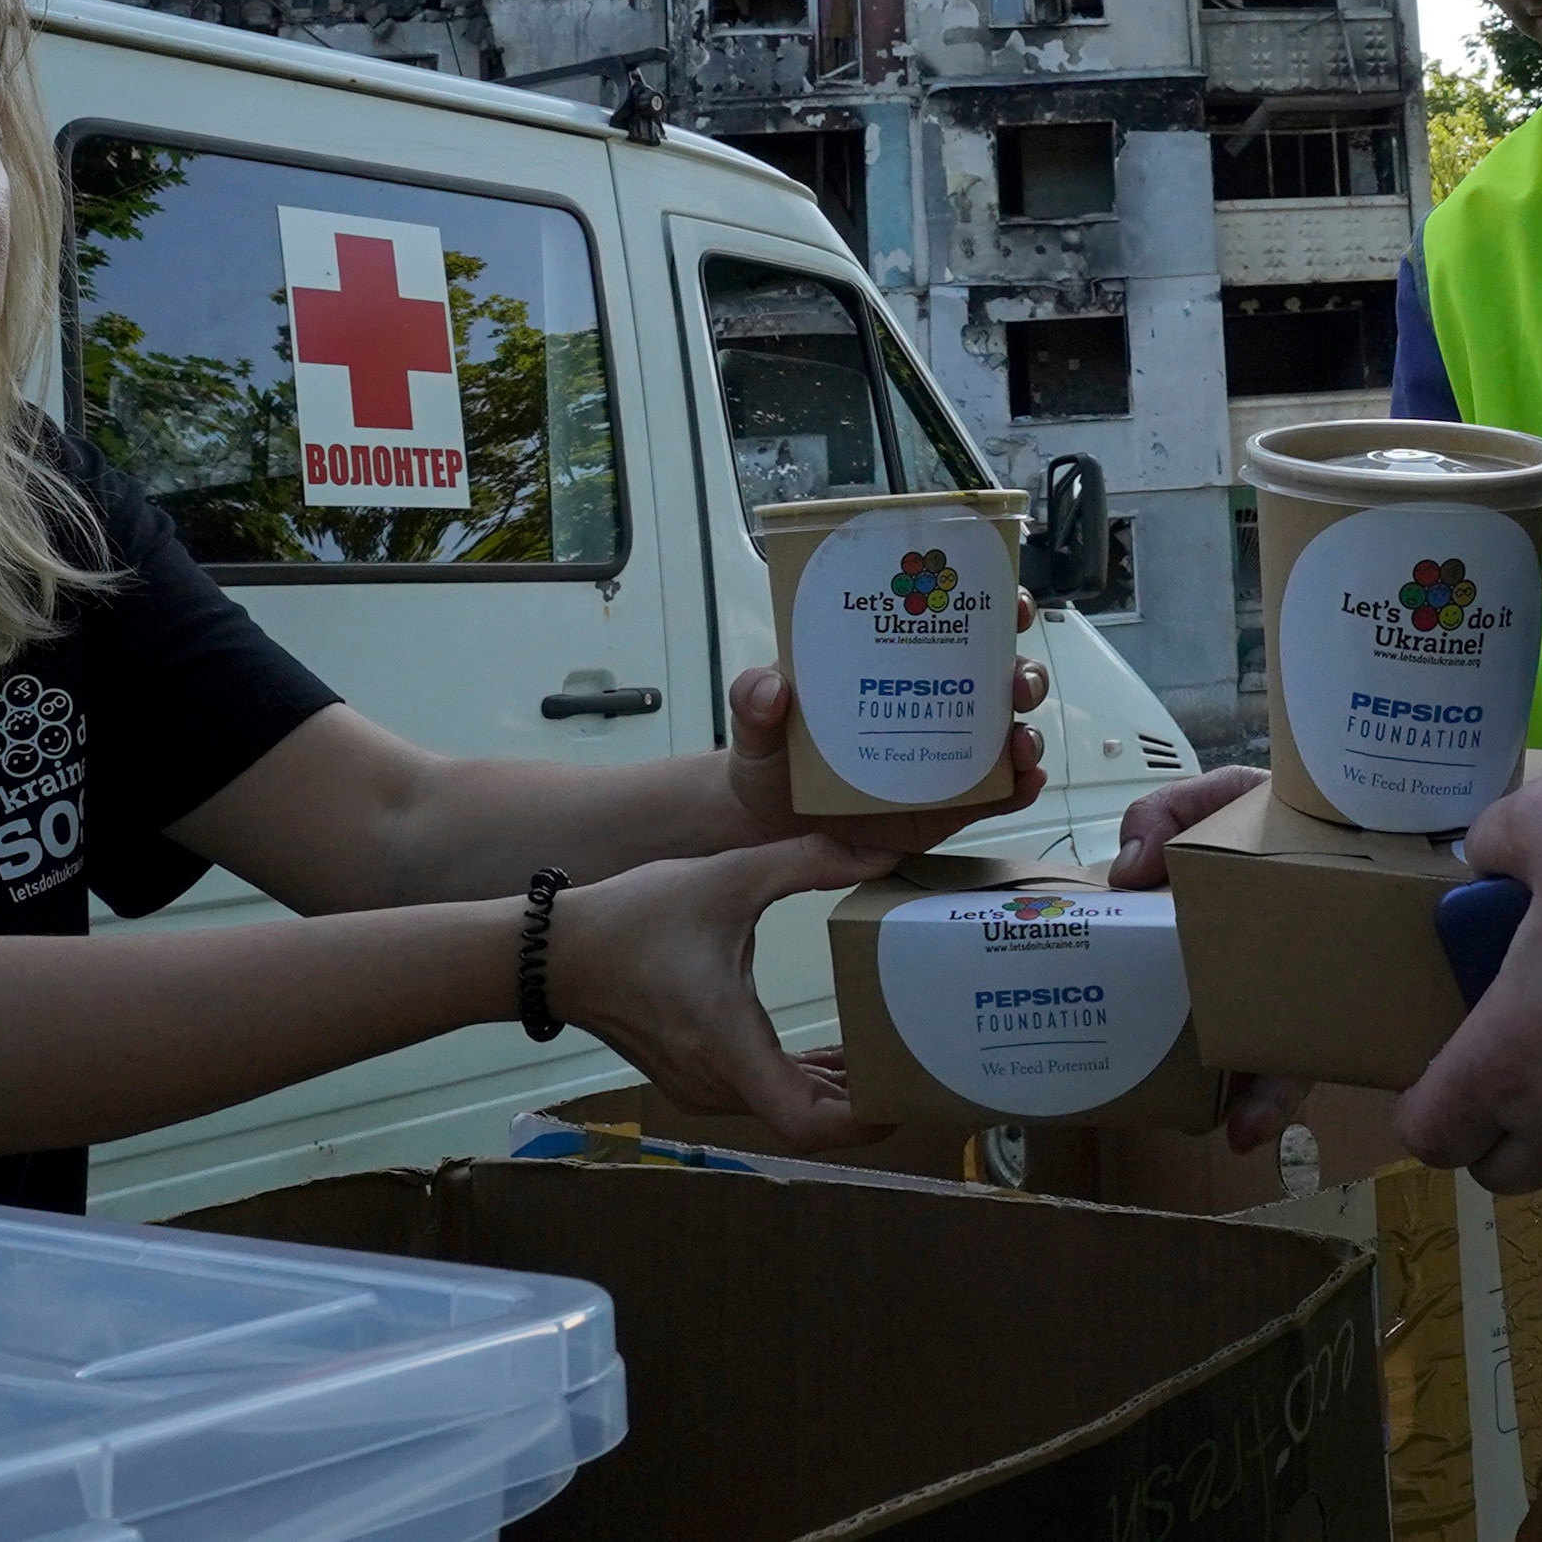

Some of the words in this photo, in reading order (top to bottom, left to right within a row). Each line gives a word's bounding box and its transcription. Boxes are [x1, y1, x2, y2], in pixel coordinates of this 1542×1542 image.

[305, 443, 462, 488] ВОЛОНТЕР
[843, 591, 894, 611] Let's
[953, 592, 976, 611] do
[980, 591, 991, 610] it
[1341, 592, 1401, 623] Let's
[1468, 608, 1495, 629] do
[1499, 606, 1513, 627] it
[875, 614, 969, 634] Ukraine!
[1375, 626, 1485, 655] Ukraine!
[1374, 649, 1481, 667] www.letsdoitukraine.org
[860, 678, 974, 696] PEPSICO
[858, 701, 974, 719] FOUNDATION
[1350, 692, 1483, 724] PEPSICO
[1347, 716, 1482, 749] FOUNDATION
[858, 747, 880, 761] We
[884, 747, 915, 761] Feed
[919, 746, 972, 761] Potential
[1343, 764, 1366, 784] We
[1371, 773, 1406, 792] Feed
[1411, 779, 1474, 796] Potential
[949, 909, 1004, 920] Let's
[1070, 907, 1099, 917] do
[1105, 907, 1124, 916] it
[982, 919, 1090, 942] Ukraine!
[975, 985, 1104, 1009] PEPSICO
[977, 1008, 1107, 1032] FOUNDATION
[981, 1062, 1005, 1076] We
[1011, 1061, 1043, 1075] Feed
[1048, 1057, 1110, 1074] Potential
